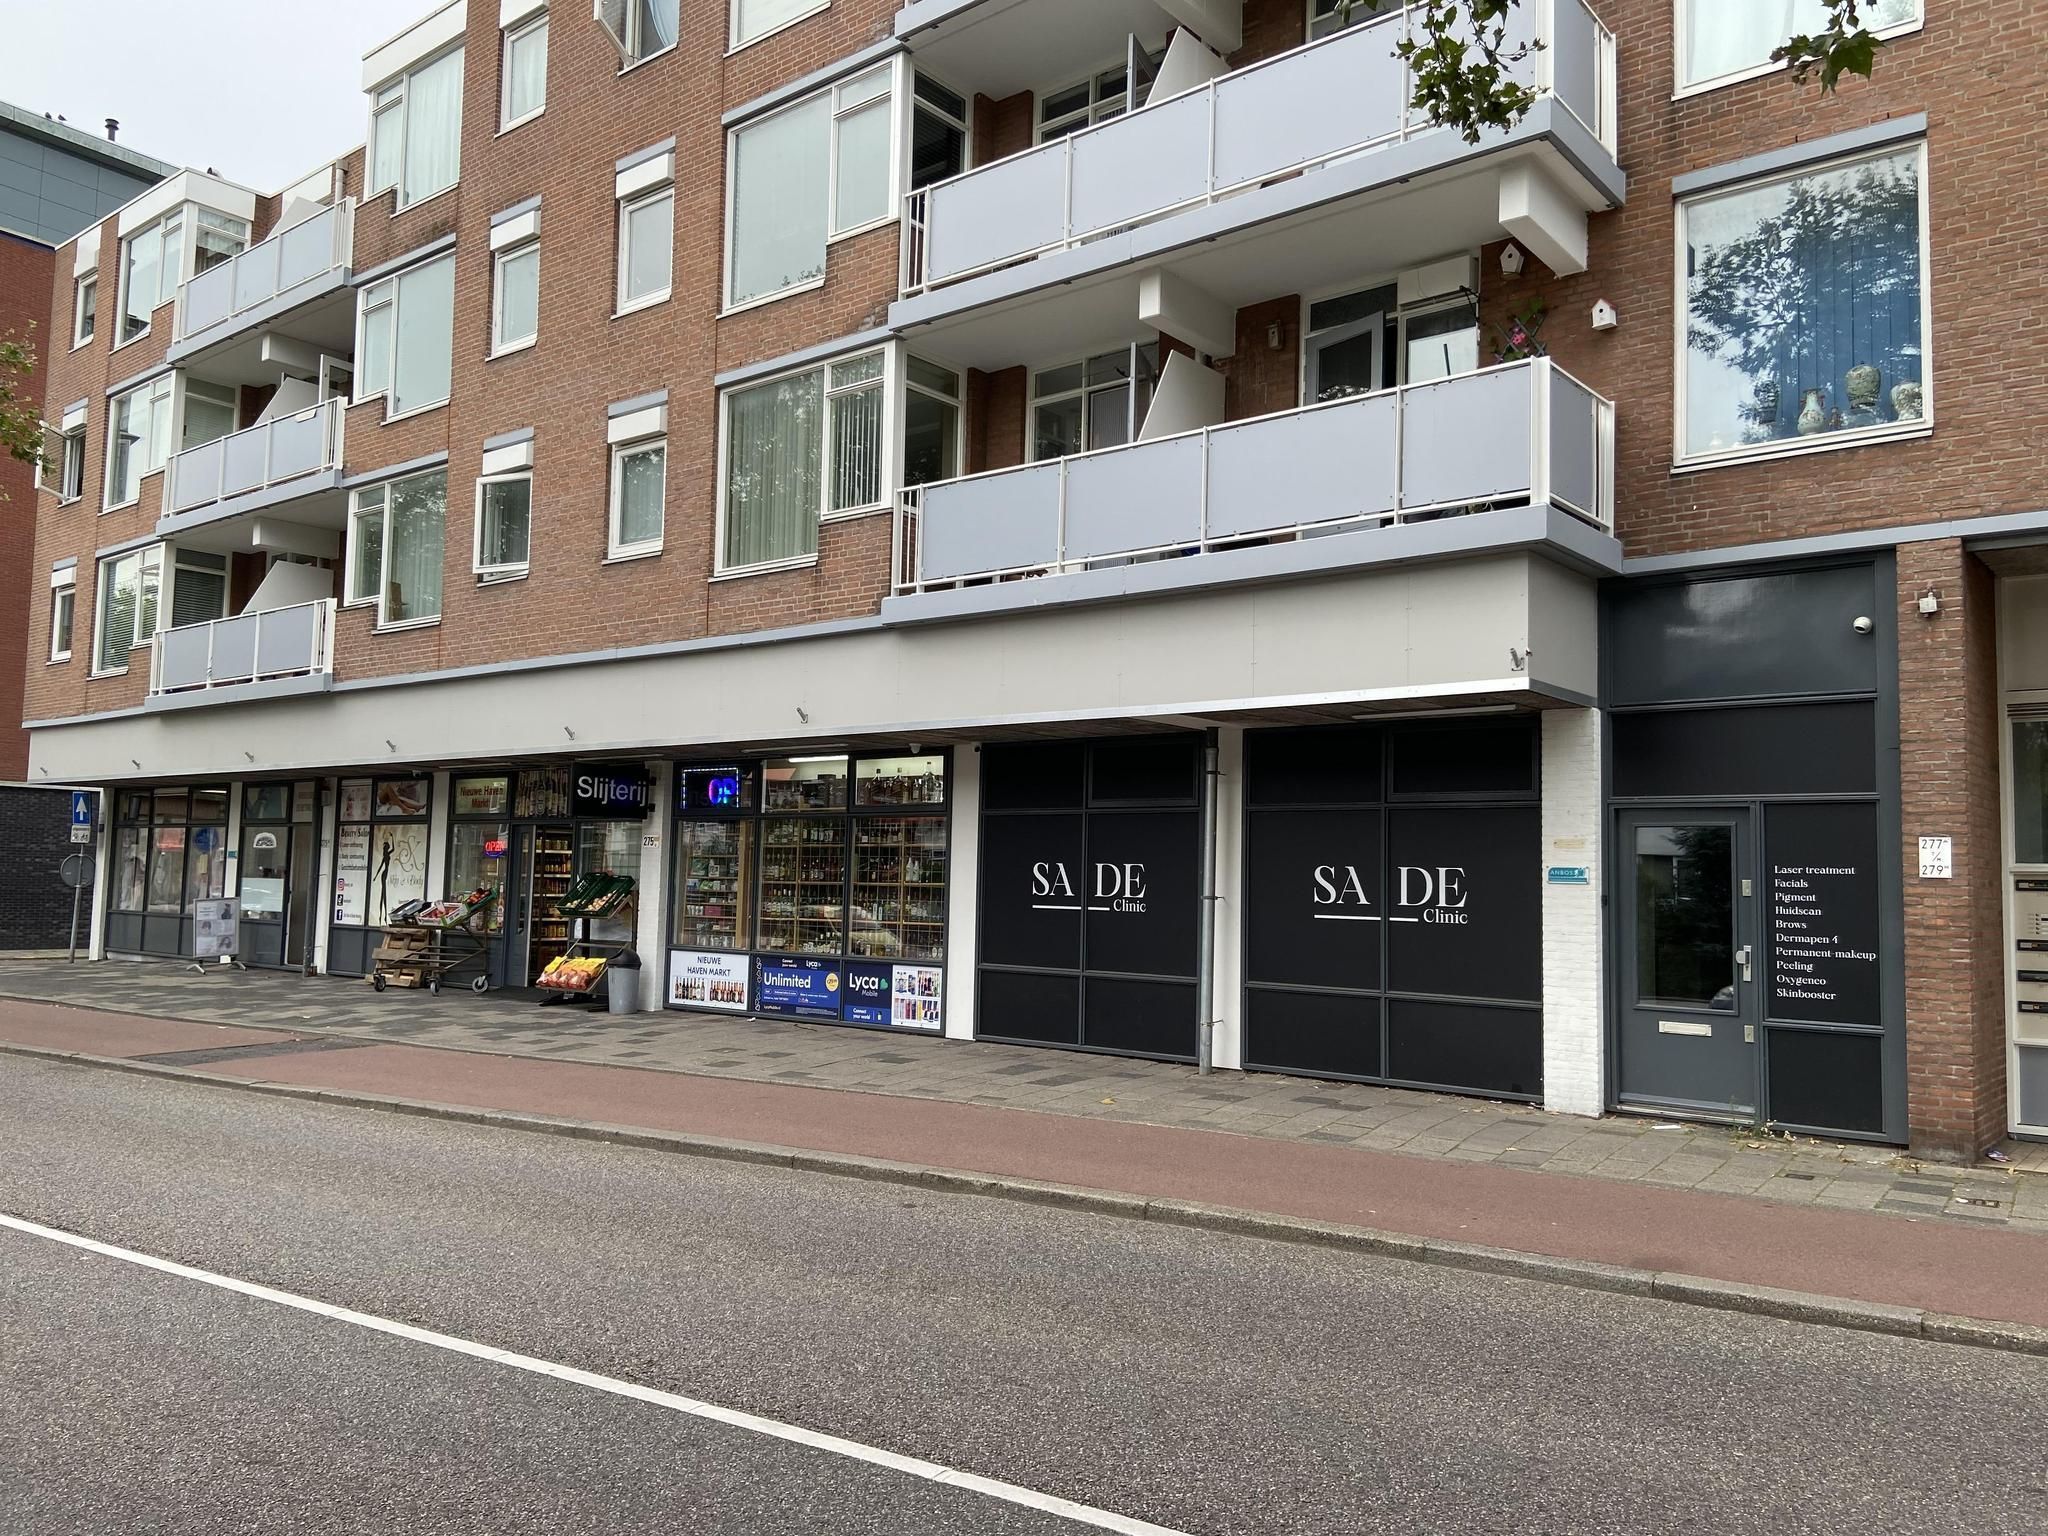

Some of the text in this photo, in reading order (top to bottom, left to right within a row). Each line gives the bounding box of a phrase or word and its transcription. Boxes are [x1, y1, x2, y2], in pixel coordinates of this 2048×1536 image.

[577, 775, 647, 807] Slijterij
[485, 841, 505, 852] OPEN
[643, 836, 654, 846] 275
[1774, 865, 1856, 875] Laser treatment
[1774, 879, 1809, 888] Facials
[1775, 892, 1816, 904] Pigment
[1113, 898, 1147, 913] Clinic
[1775, 906, 1822, 916] Huidscan
[1423, 908, 1468, 925] Clinic
[1775, 919, 1807, 929] Brows
[1776, 933, 1829, 945] Dermapen
[697, 956, 721, 965] NIEUWE
[806, 960, 818, 968] Lyca
[687, 966, 731, 977] HAVEN MARKT
[1776, 960, 1814, 973] Peeling
[764, 972, 811, 988] Unlimited
[849, 972, 879, 990] Lyca
[1776, 974, 1827, 986] Oxygeneo
[861, 989, 878, 997] Mobile
[1776, 988, 1837, 1000] Skinbooster
